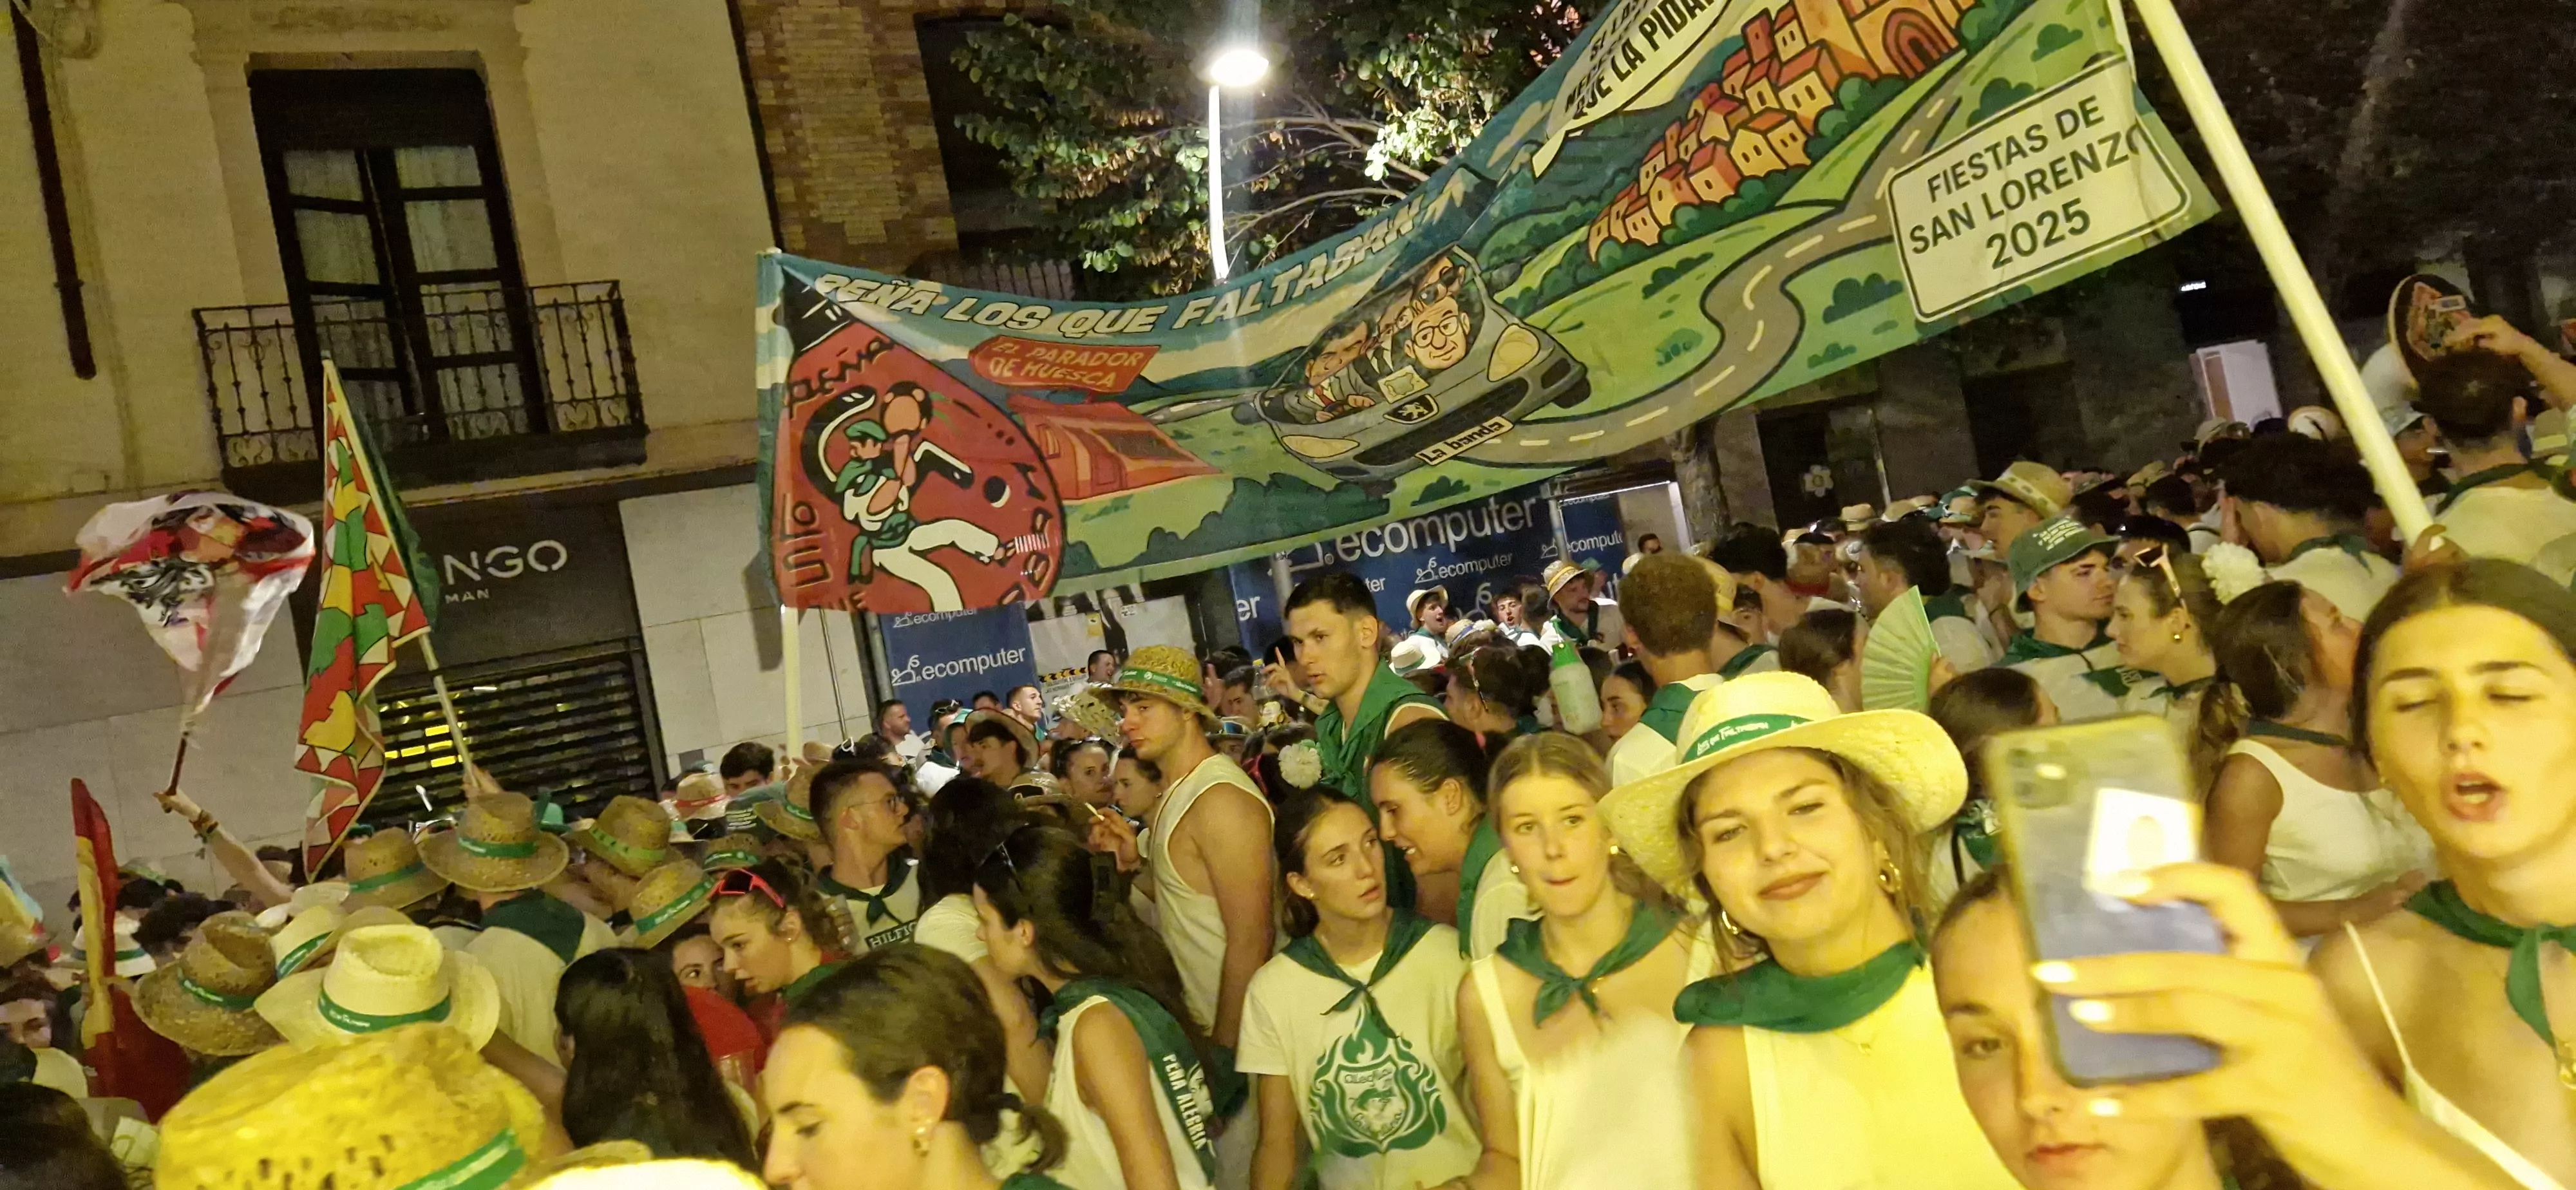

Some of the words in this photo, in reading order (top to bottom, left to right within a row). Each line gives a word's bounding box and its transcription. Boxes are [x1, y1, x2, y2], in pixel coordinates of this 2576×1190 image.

[1572, 69, 1613, 120] QUE
[1611, 38, 1646, 82] LA
[1638, 0, 1715, 52] PIDA
[1927, 124, 2049, 203] FIESTAS
[2054, 95, 2105, 141] DE
[1909, 202, 1976, 255] SAN
[1985, 197, 2091, 270] 2025
[815, 273, 941, 316] PEÑA
[943, 297, 1052, 330] LOS
[1058, 305, 1168, 339] QUE
[989, 357, 1021, 377] DE
[1019, 361, 1117, 388] HUESCA
[1025, 346, 1145, 367] PARADOR
[1418, 448, 1448, 463] La
[1442, 421, 1506, 451] banda
[443, 539, 568, 585] NGO
[445, 588, 490, 604] MAN
